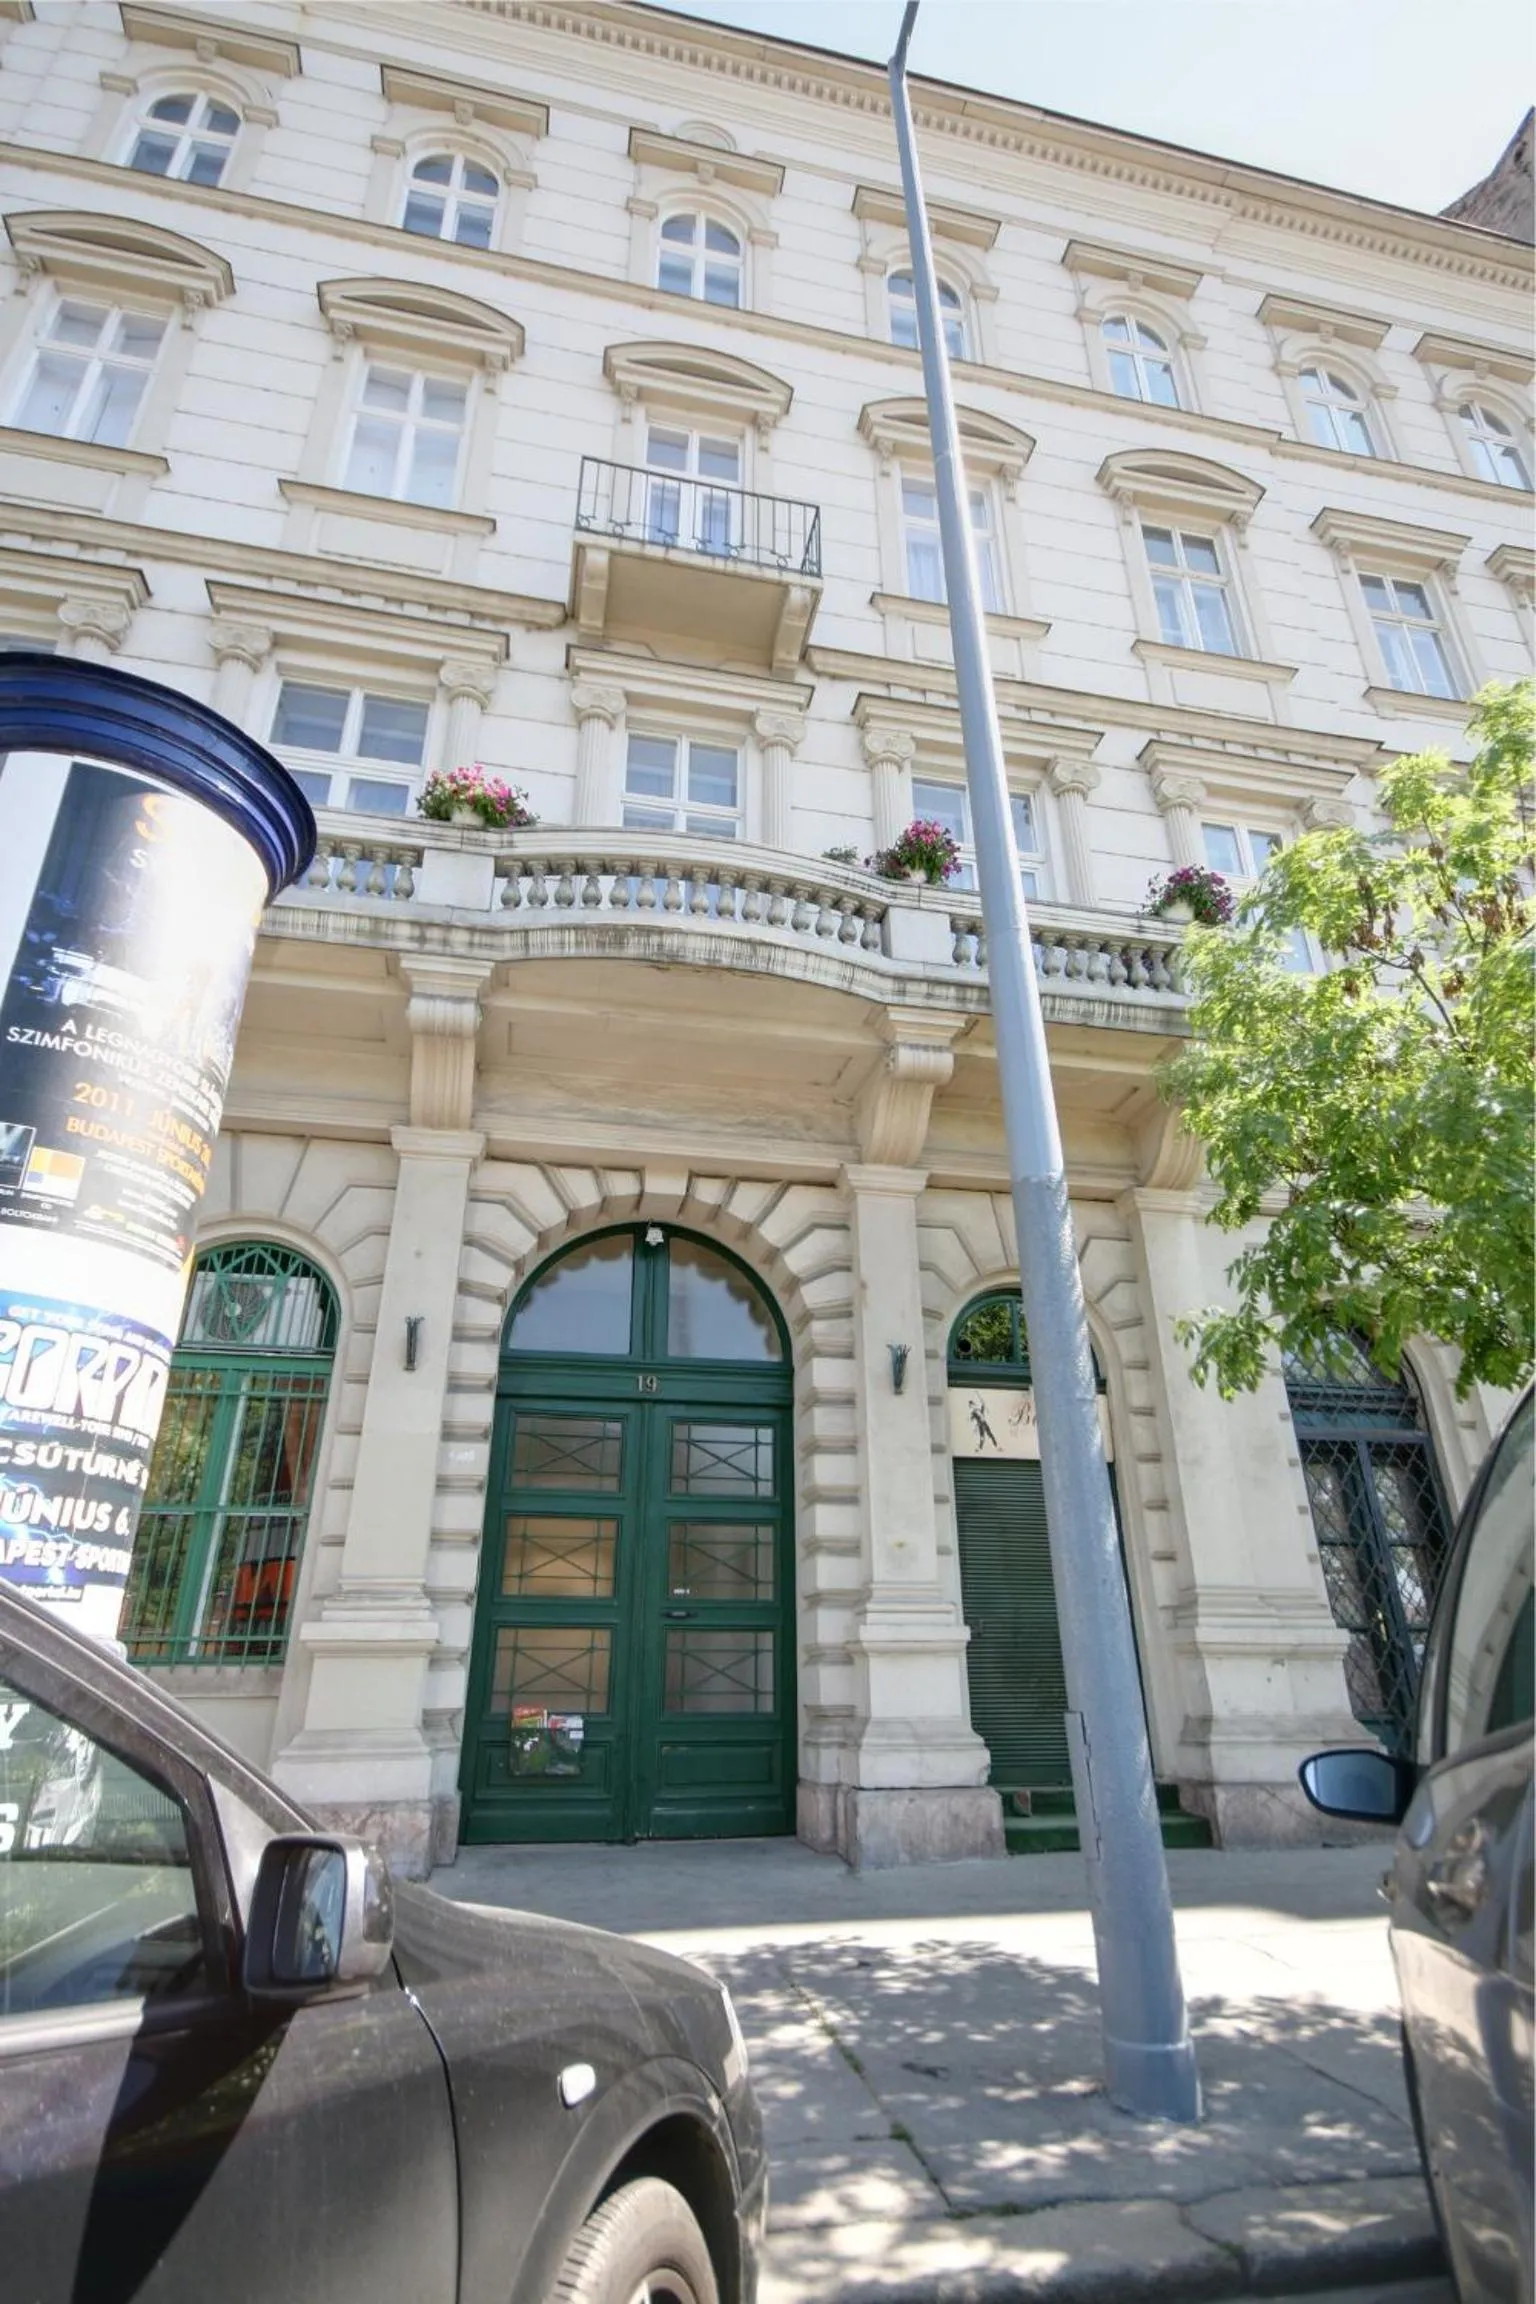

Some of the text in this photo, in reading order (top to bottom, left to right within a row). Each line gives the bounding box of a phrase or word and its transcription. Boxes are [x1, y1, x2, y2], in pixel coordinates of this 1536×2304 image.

[61, 1019, 78, 1035] A
[66, 1115, 156, 1156] BUDAPEST
[637, 1374, 658, 1393] 19
